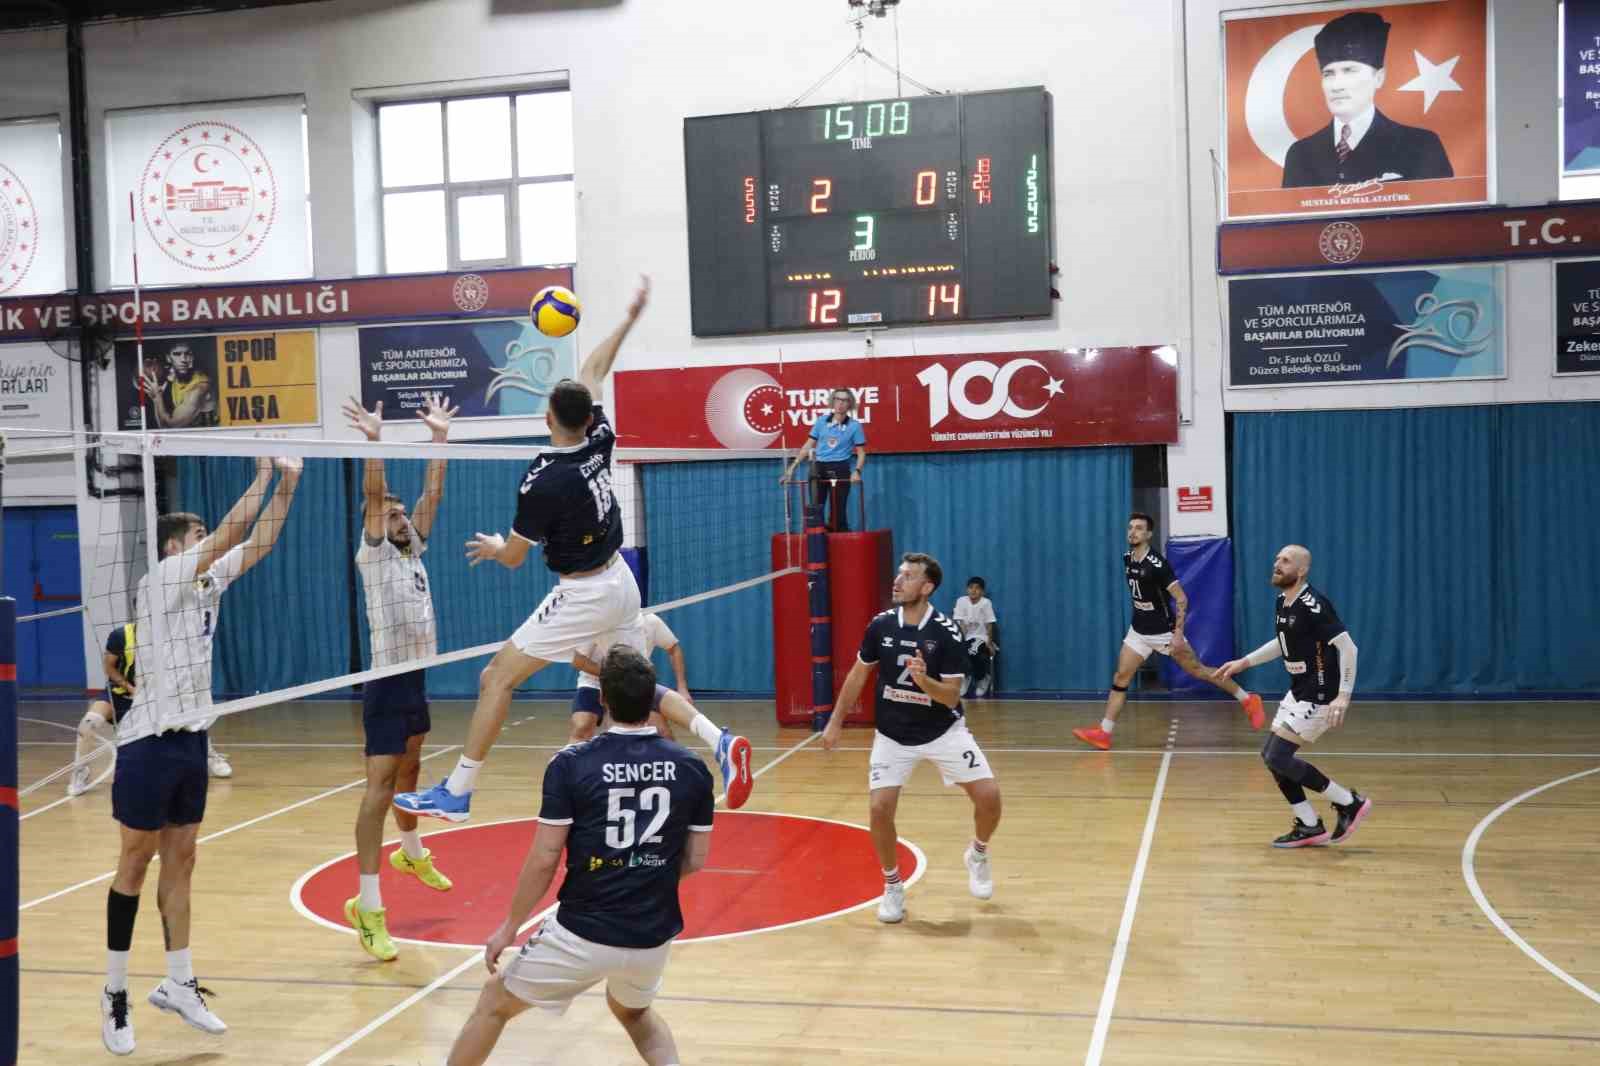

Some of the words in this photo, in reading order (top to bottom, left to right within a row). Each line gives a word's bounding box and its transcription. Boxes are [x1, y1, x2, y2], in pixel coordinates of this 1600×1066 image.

[851, 137, 872, 150] TIME
[811, 180, 831, 213] 2
[916, 171, 937, 205] 0
[854, 215, 873, 250] 3
[1503, 218, 1581, 246] T.C.
[849, 249, 876, 262] PERIOD
[34, 305, 71, 328] VE
[82, 301, 160, 326] SPOR
[172, 285, 350, 321] BAKANLIĞI
[810, 290, 841, 324] 12
[928, 284, 960, 317] 14
[1257, 302, 1284, 316] TÜM
[1288, 300, 1351, 315] ANTRENÖR
[1573, 302, 1589, 313] VE
[1244, 318, 1259, 329] VE
[1262, 314, 1366, 328] SPORCULARIMIZA
[1244, 330, 1303, 343] BAŞARILAR
[1305, 326, 1365, 339] DİLİYORUM
[224, 337, 277, 363] SPOR
[383, 350, 403, 360] TÜM
[406, 347, 456, 359] ANTRENÖR
[1268, 355, 1283, 365] Dr.
[1286, 353, 1312, 364] Faruk
[1314, 351, 1341, 362] ÖZLÜ
[385, 358, 468, 370] SPORCULARIMIZA
[1250, 364, 1280, 375] Düzce
[1281, 362, 1322, 375] Belediye
[1323, 359, 1361, 372] Başkanı
[227, 365, 252, 389] LA
[226, 394, 280, 423] YAŞA
[962, 750, 981, 769] 2
[602, 761, 677, 783] SENCER
[605, 786, 671, 849] 52
